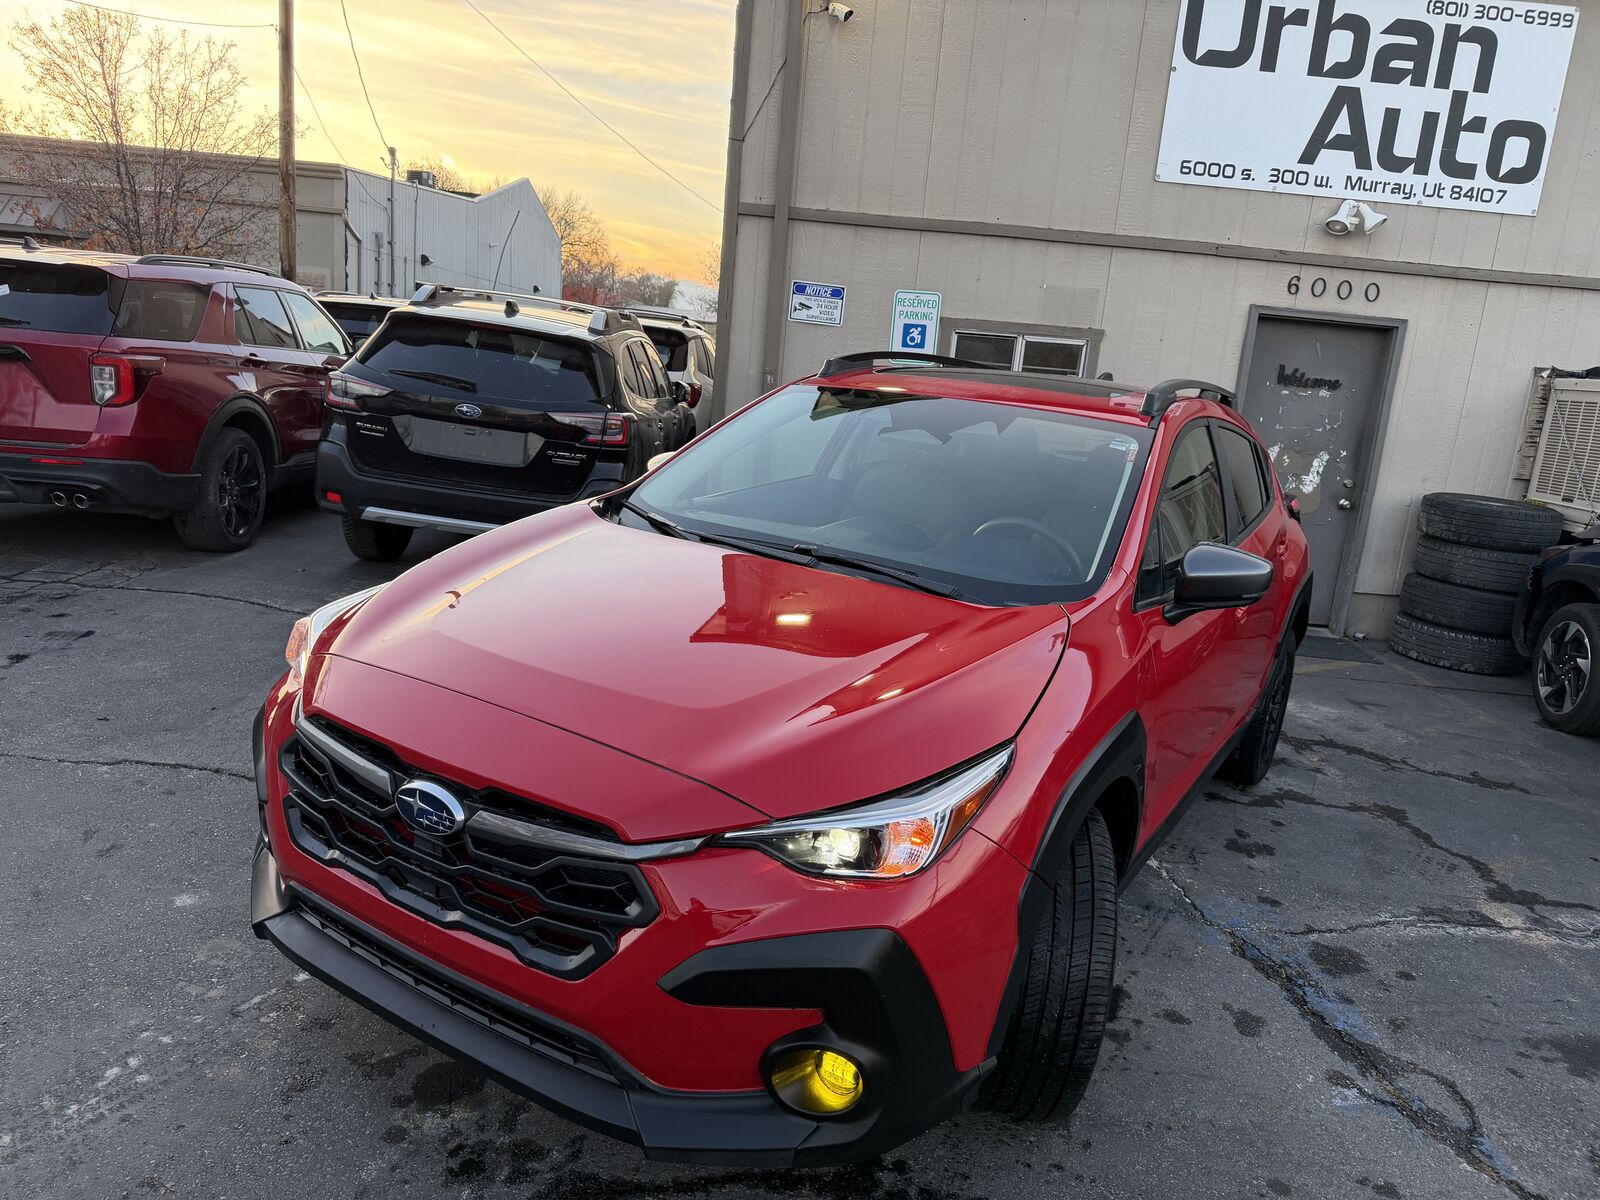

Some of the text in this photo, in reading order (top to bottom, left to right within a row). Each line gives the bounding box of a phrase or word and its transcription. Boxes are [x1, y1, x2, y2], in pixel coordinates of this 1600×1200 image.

[1426, 0, 1575, 28] (801) 300-6999
[1182, 0, 1499, 94] Urban
[1298, 85, 1547, 185] Auto
[1179, 160, 1236, 179] 6000
[1240, 168, 1255, 181] s.
[1268, 168, 1310, 186] 300
[1344, 175, 1417, 200] Murray,
[1422, 182, 1445, 199] Ut
[1450, 185, 1508, 204] 84107
[805, 285, 833, 297] NOTICE
[1287, 275, 1380, 302] 6000
[897, 297, 938, 309] RESERVED
[898, 310, 934, 322] PARKING
